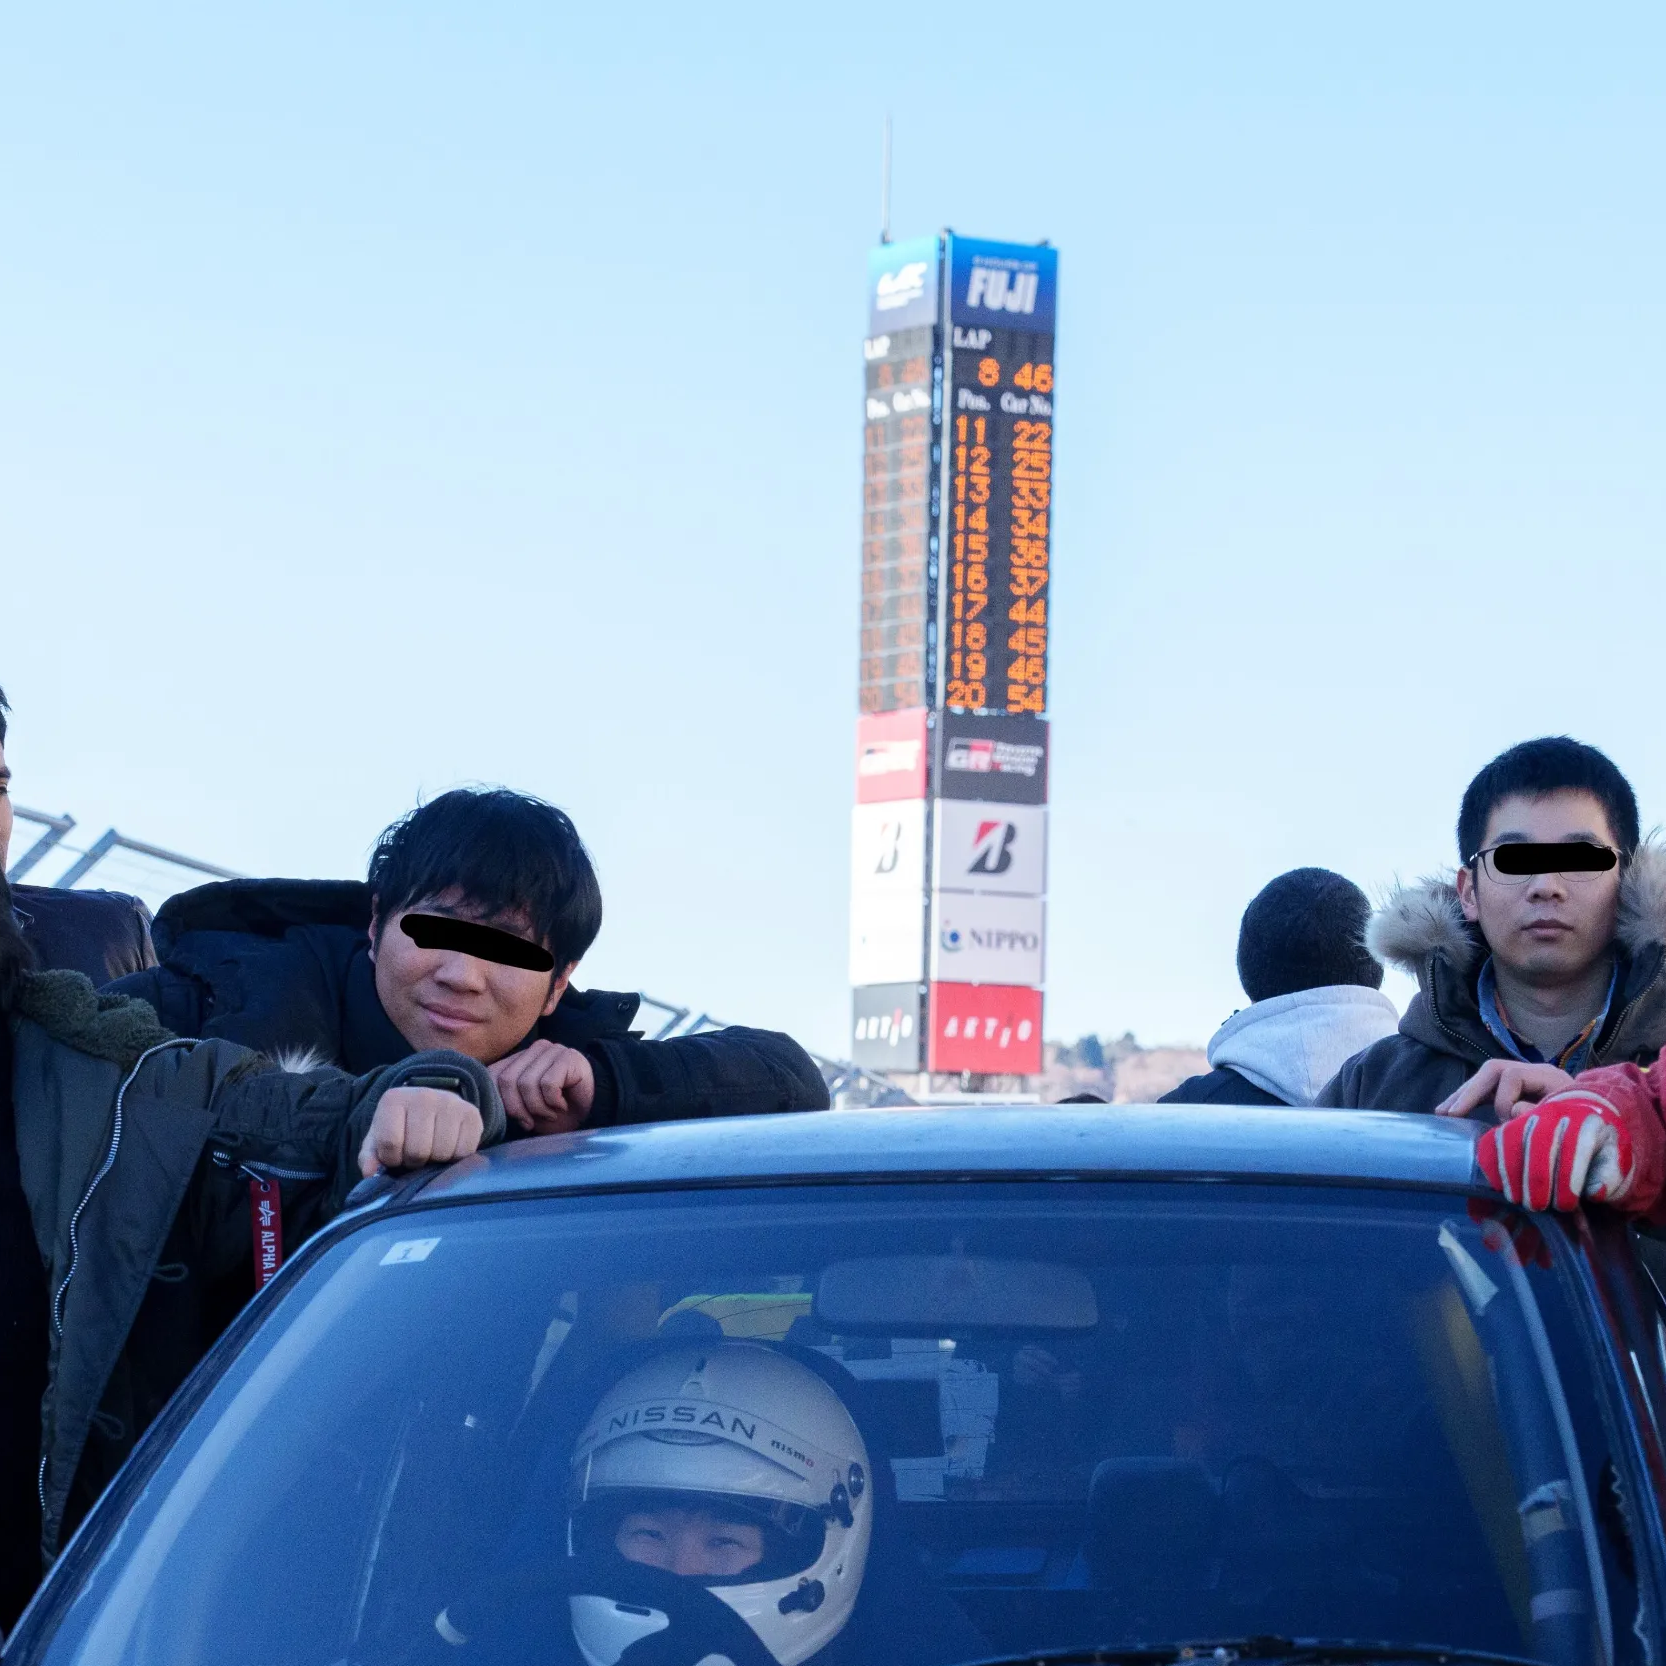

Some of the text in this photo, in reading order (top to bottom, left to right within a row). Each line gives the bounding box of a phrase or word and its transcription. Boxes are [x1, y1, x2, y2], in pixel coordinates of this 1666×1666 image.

[967, 266, 1039, 315] FUJI
[953, 326, 992, 350] LAP
[978, 357, 1001, 387] 8
[956, 415, 1052, 450] 11 22
[955, 444, 1051, 480] 12 25
[954, 473, 991, 504] 13
[953, 502, 1049, 538] 14 34
[953, 532, 989, 562] 15
[952, 562, 1049, 596] 16 37
[952, 592, 1046, 626] 17 44
[951, 621, 1047, 655] 18 45
[950, 650, 987, 680] 19
[946, 680, 1045, 713] 20 54
[970, 928, 1039, 952] NIPPO
[261, 1230, 276, 1270] ALPHA
[608, 1405, 757, 1441] NISSAN
[770, 1438, 815, 1468] nismo
